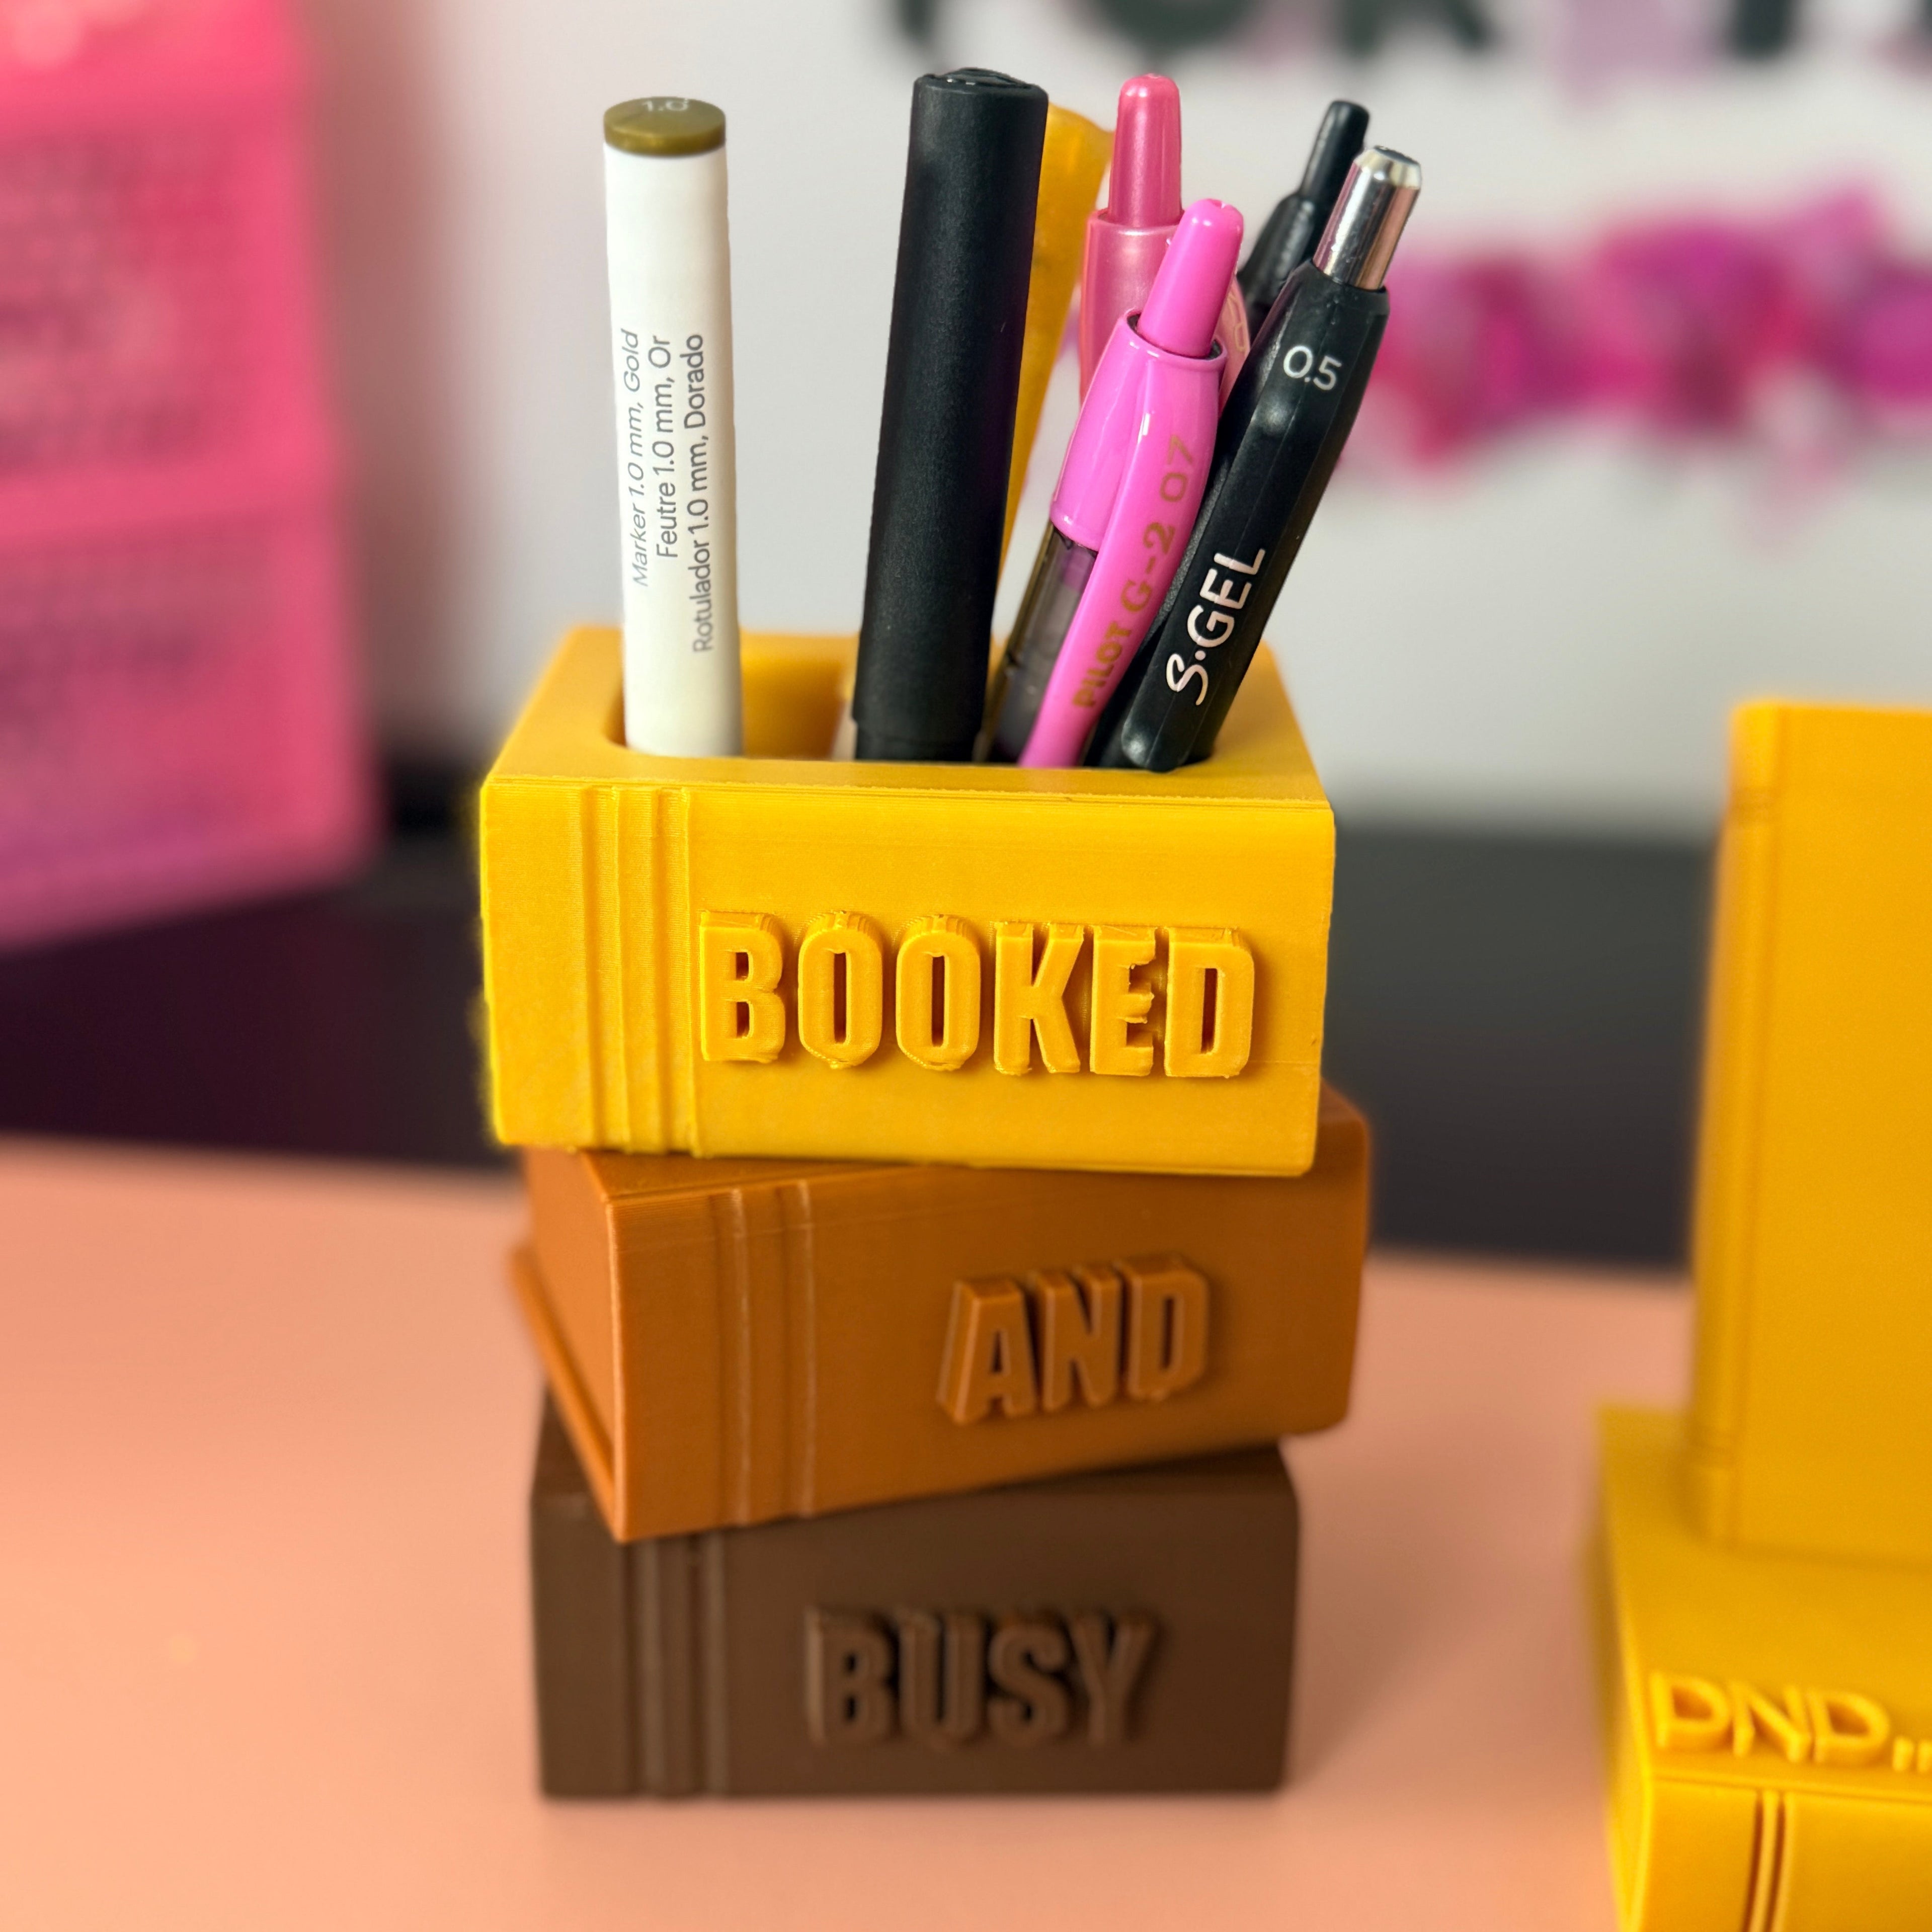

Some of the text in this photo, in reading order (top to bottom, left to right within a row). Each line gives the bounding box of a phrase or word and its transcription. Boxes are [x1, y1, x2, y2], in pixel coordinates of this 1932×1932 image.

[621, 328, 649, 587] Marker 1.0 mm, Gold
[648, 335, 678, 558] Feutre 1.0 mm, Or
[680, 334, 713, 653] Rotulador 1.0 mm, Dorado
[1074, 434, 1194, 707] PILOT G-2 07
[700, 910, 1254, 1077] BOOKED
[936, 1257, 1208, 1425] AND
[806, 1607, 1156, 1751] BUSY
